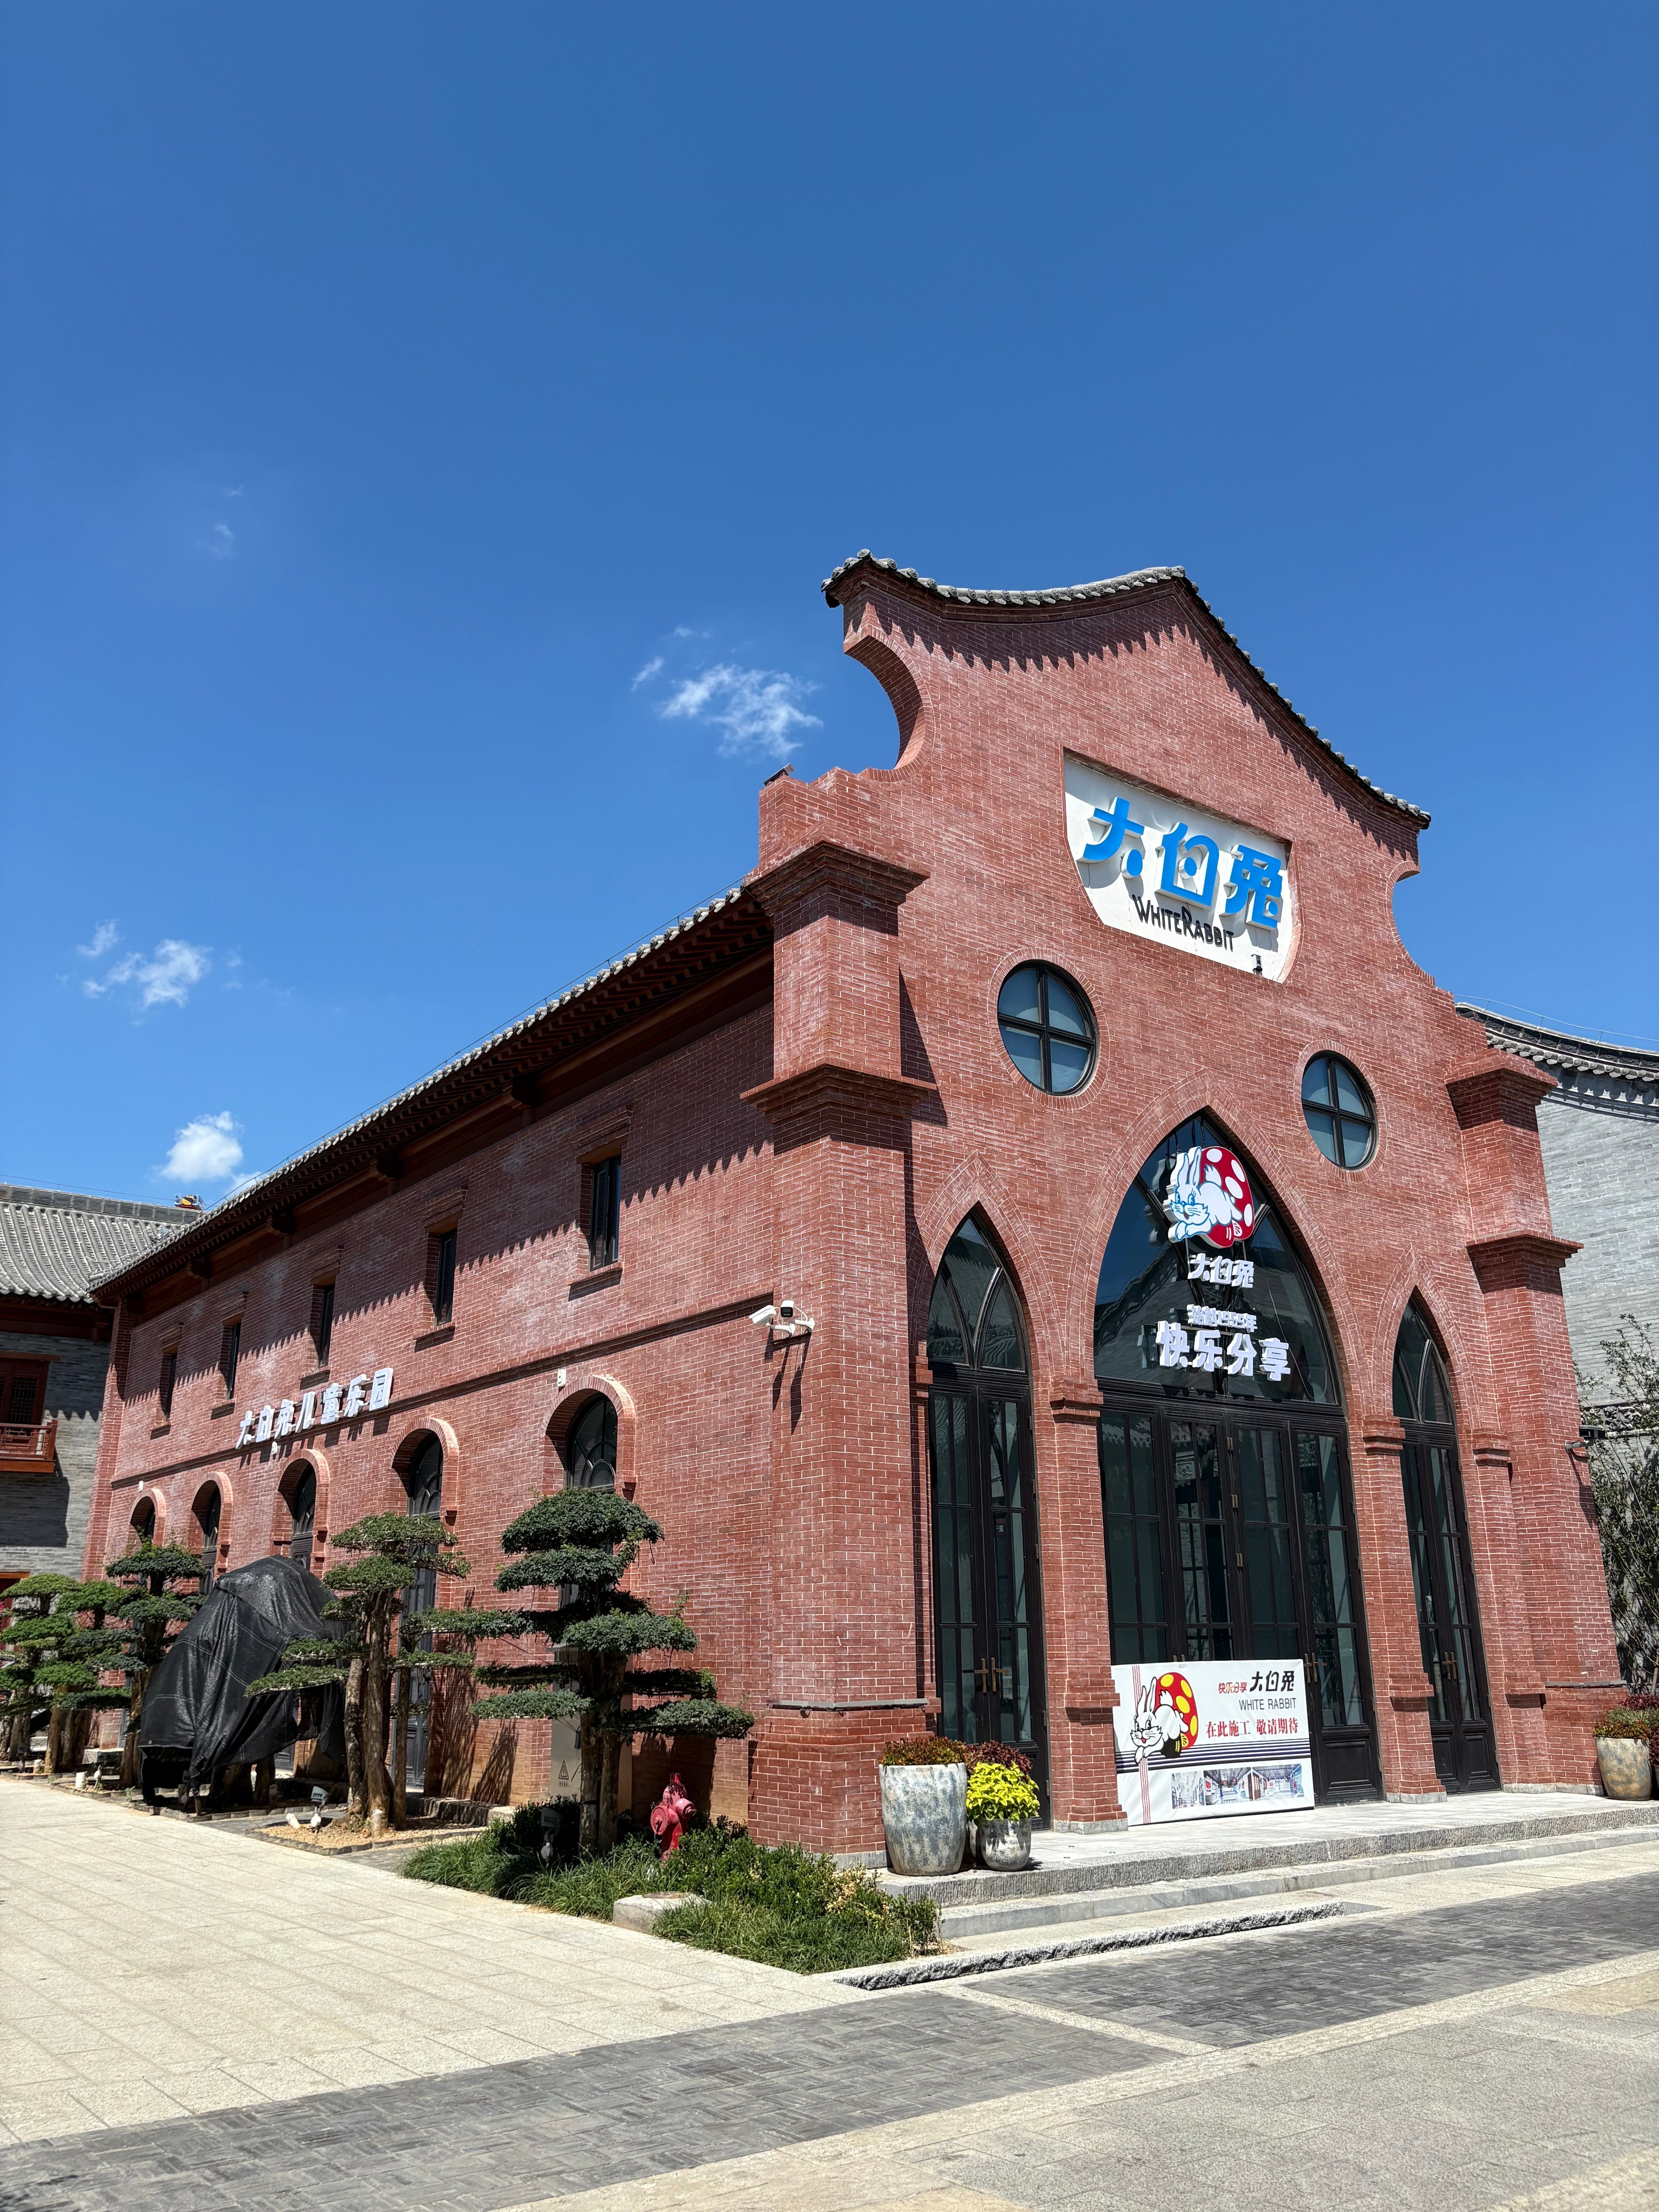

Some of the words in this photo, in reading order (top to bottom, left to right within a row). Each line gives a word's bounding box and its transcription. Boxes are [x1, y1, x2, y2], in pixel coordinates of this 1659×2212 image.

[1079, 797, 1283, 931] 大白兔
[1188, 1253, 1254, 1288] 大白兔
[1155, 1321, 1291, 1381] 快乐分享
[235, 1367, 394, 1449] 大白兔儿童乐园
[1218, 1681, 1248, 1694] 快乐分享
[1249, 1670, 1295, 1692] 大白兔
[1239, 1699, 1265, 1711] WHITE
[1268, 1697, 1297, 1709] RABBIT
[1206, 1720, 1251, 1739] 在此施工
[1256, 1717, 1298, 1735] 敬请期待
